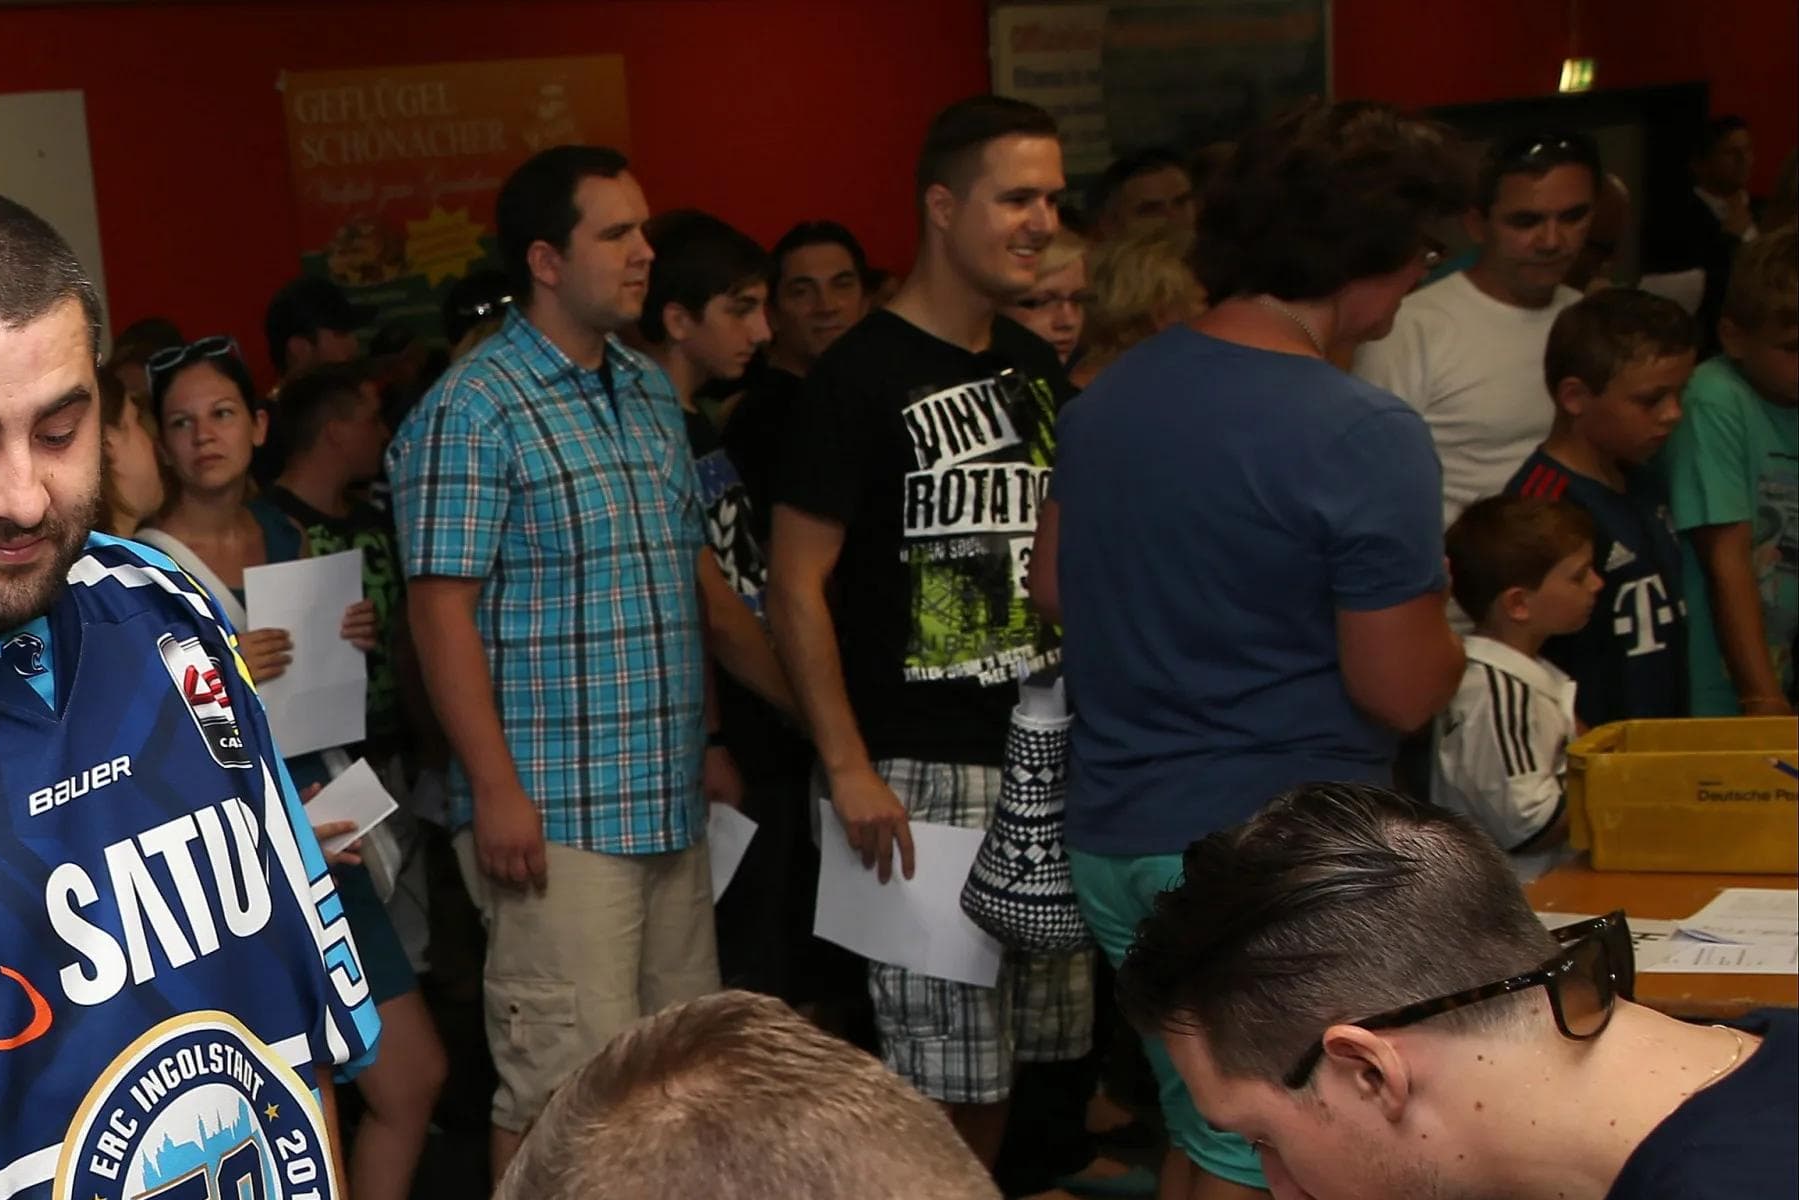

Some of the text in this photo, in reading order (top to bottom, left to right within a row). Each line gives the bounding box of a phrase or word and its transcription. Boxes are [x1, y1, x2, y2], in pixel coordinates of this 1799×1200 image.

[1697, 788, 1798, 802] Deutsche Po
[89, 1042, 265, 1181] ERC INGOLSTADT
